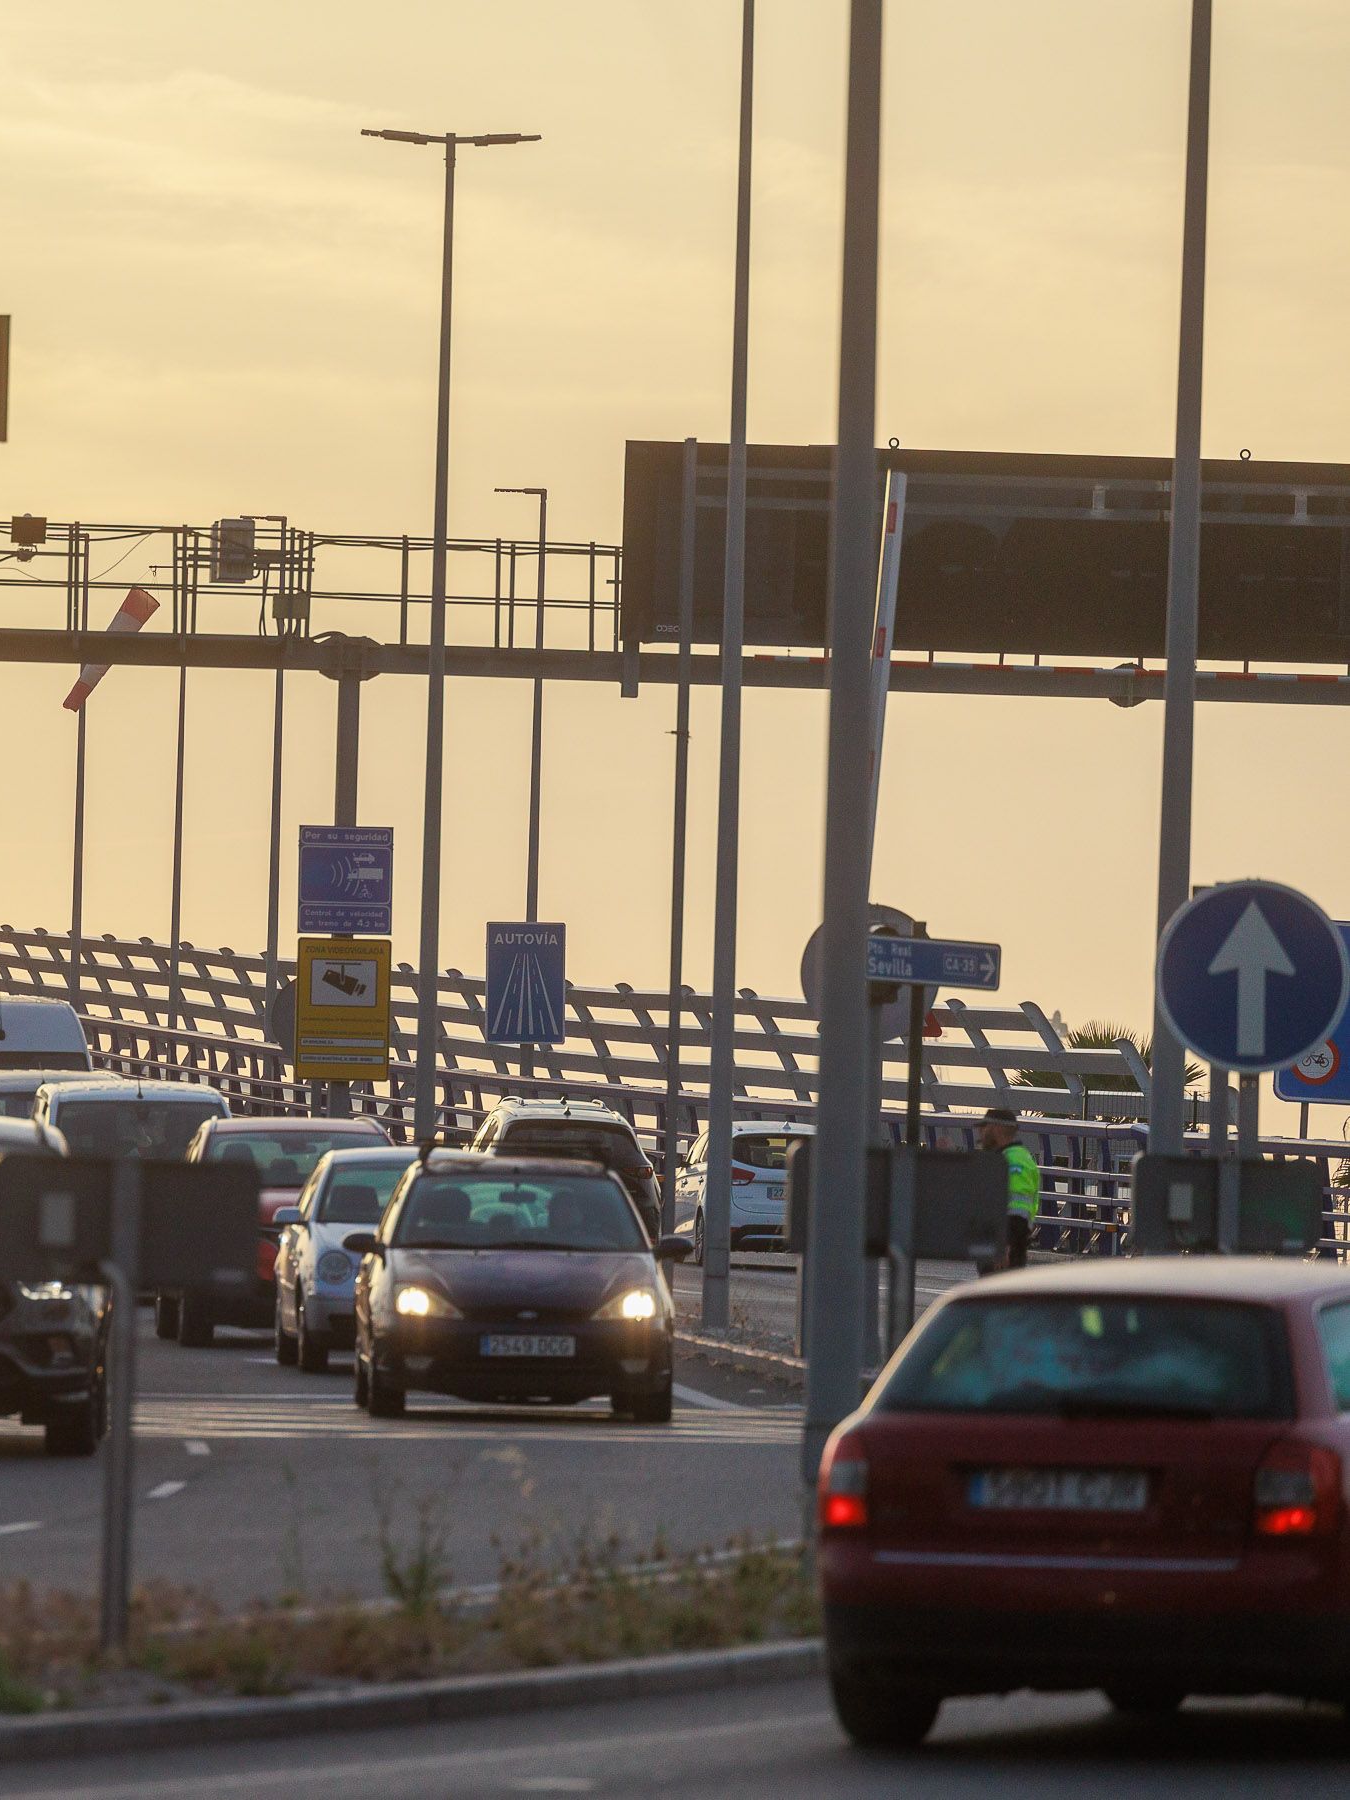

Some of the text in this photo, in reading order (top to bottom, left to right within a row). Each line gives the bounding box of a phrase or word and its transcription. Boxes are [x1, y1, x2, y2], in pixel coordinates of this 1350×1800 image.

[305, 831, 321, 840] Por
[344, 832, 388, 842] seguridad
[305, 909, 332, 917] Control
[494, 931, 558, 945] AUTOVÍA
[305, 945, 384, 955] ZONA VIDEOVIGILADA
[868, 957, 912, 976] Sevilla
